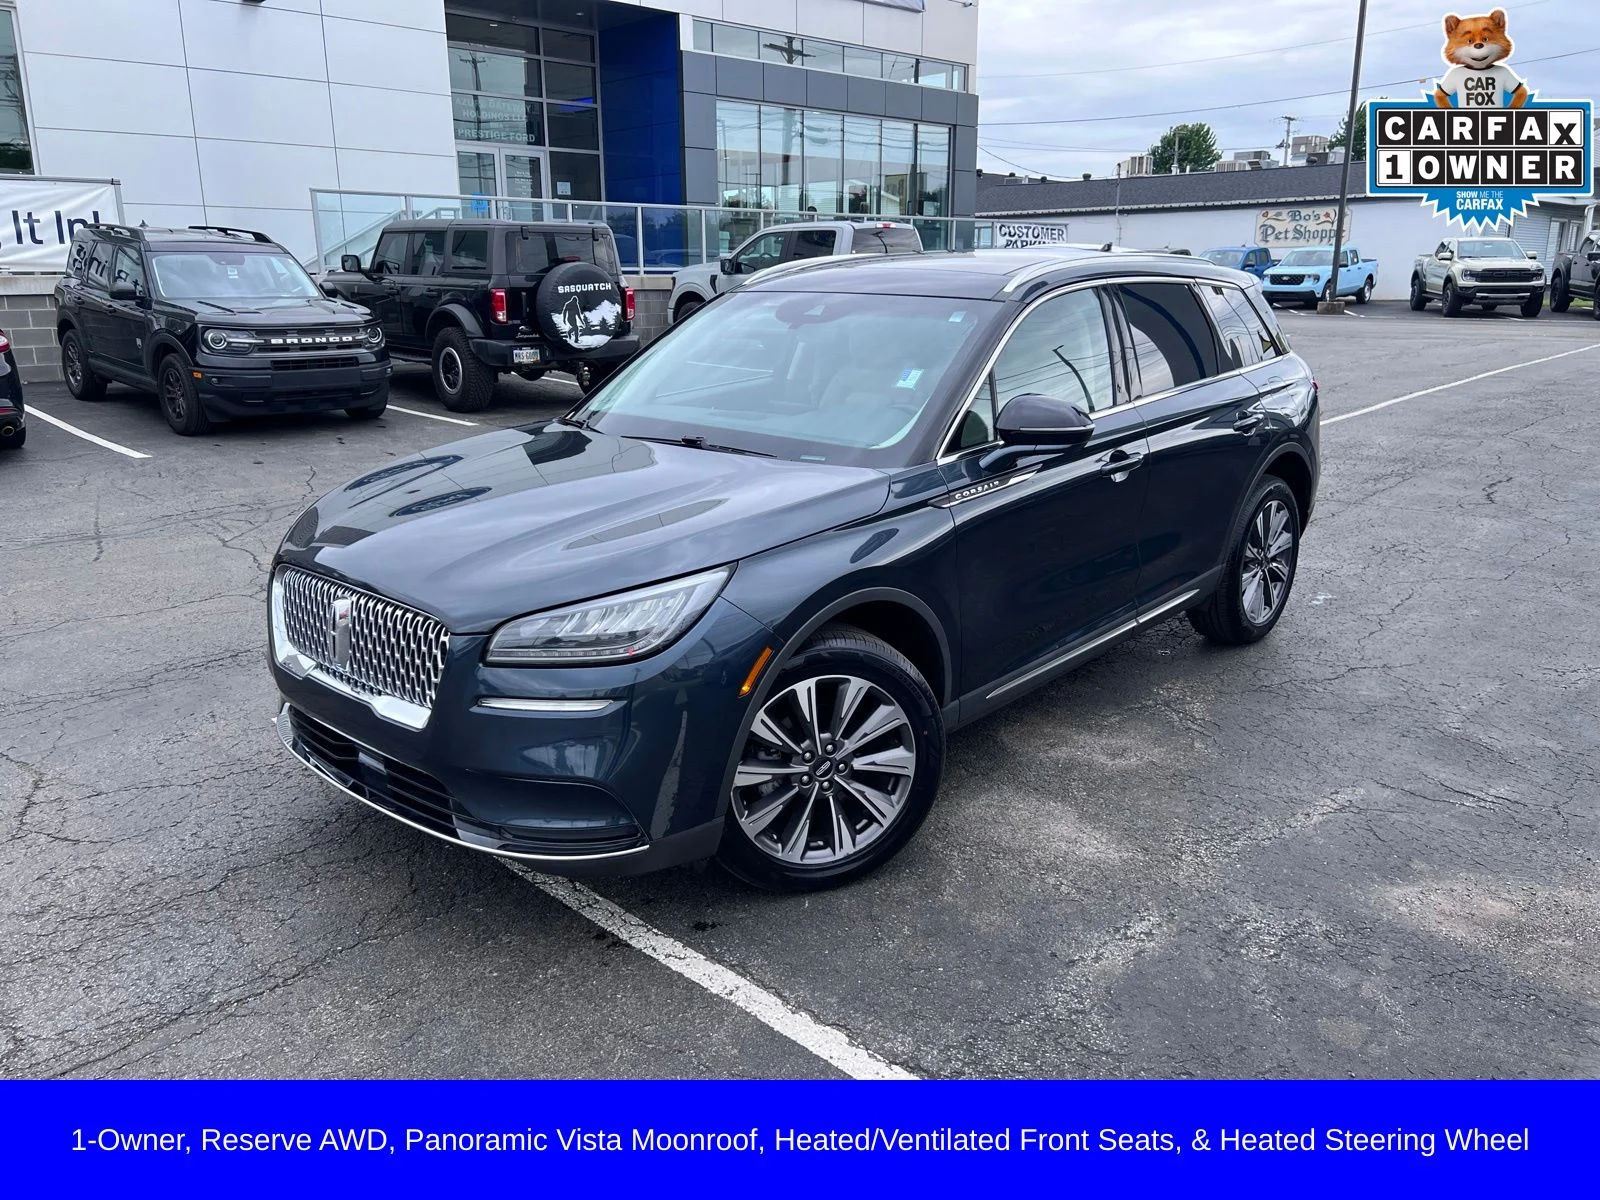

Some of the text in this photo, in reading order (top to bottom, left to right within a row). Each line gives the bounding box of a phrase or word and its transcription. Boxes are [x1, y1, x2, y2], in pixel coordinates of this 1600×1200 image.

[458, 129, 536, 142] PRESTIGE FORD
[1287, 209, 1321, 223] Bo's
[12, 210, 44, 244] It
[998, 223, 1065, 242] CUSTOMER
[1259, 223, 1291, 243] Pet
[557, 282, 612, 294] SASQUATCH
[270, 336, 353, 345] BRONCO
[954, 480, 1000, 500] CORSAIR
